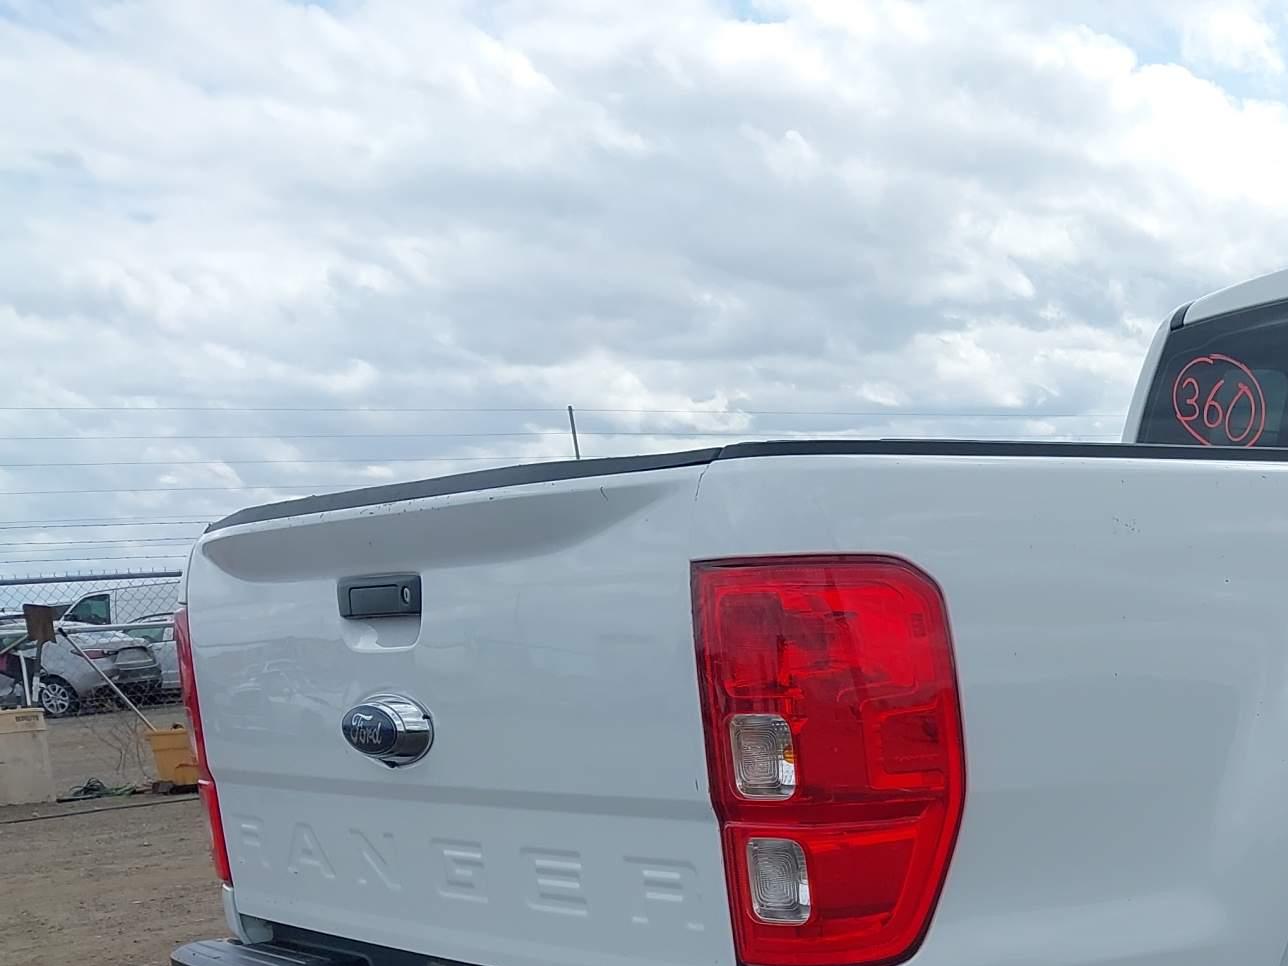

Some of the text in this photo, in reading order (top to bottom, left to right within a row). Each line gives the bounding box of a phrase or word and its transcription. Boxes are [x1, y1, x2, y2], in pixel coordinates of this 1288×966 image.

[1178, 377, 1256, 442] 360
[351, 712, 382, 744] Ford
[232, 814, 706, 930] RANGER
